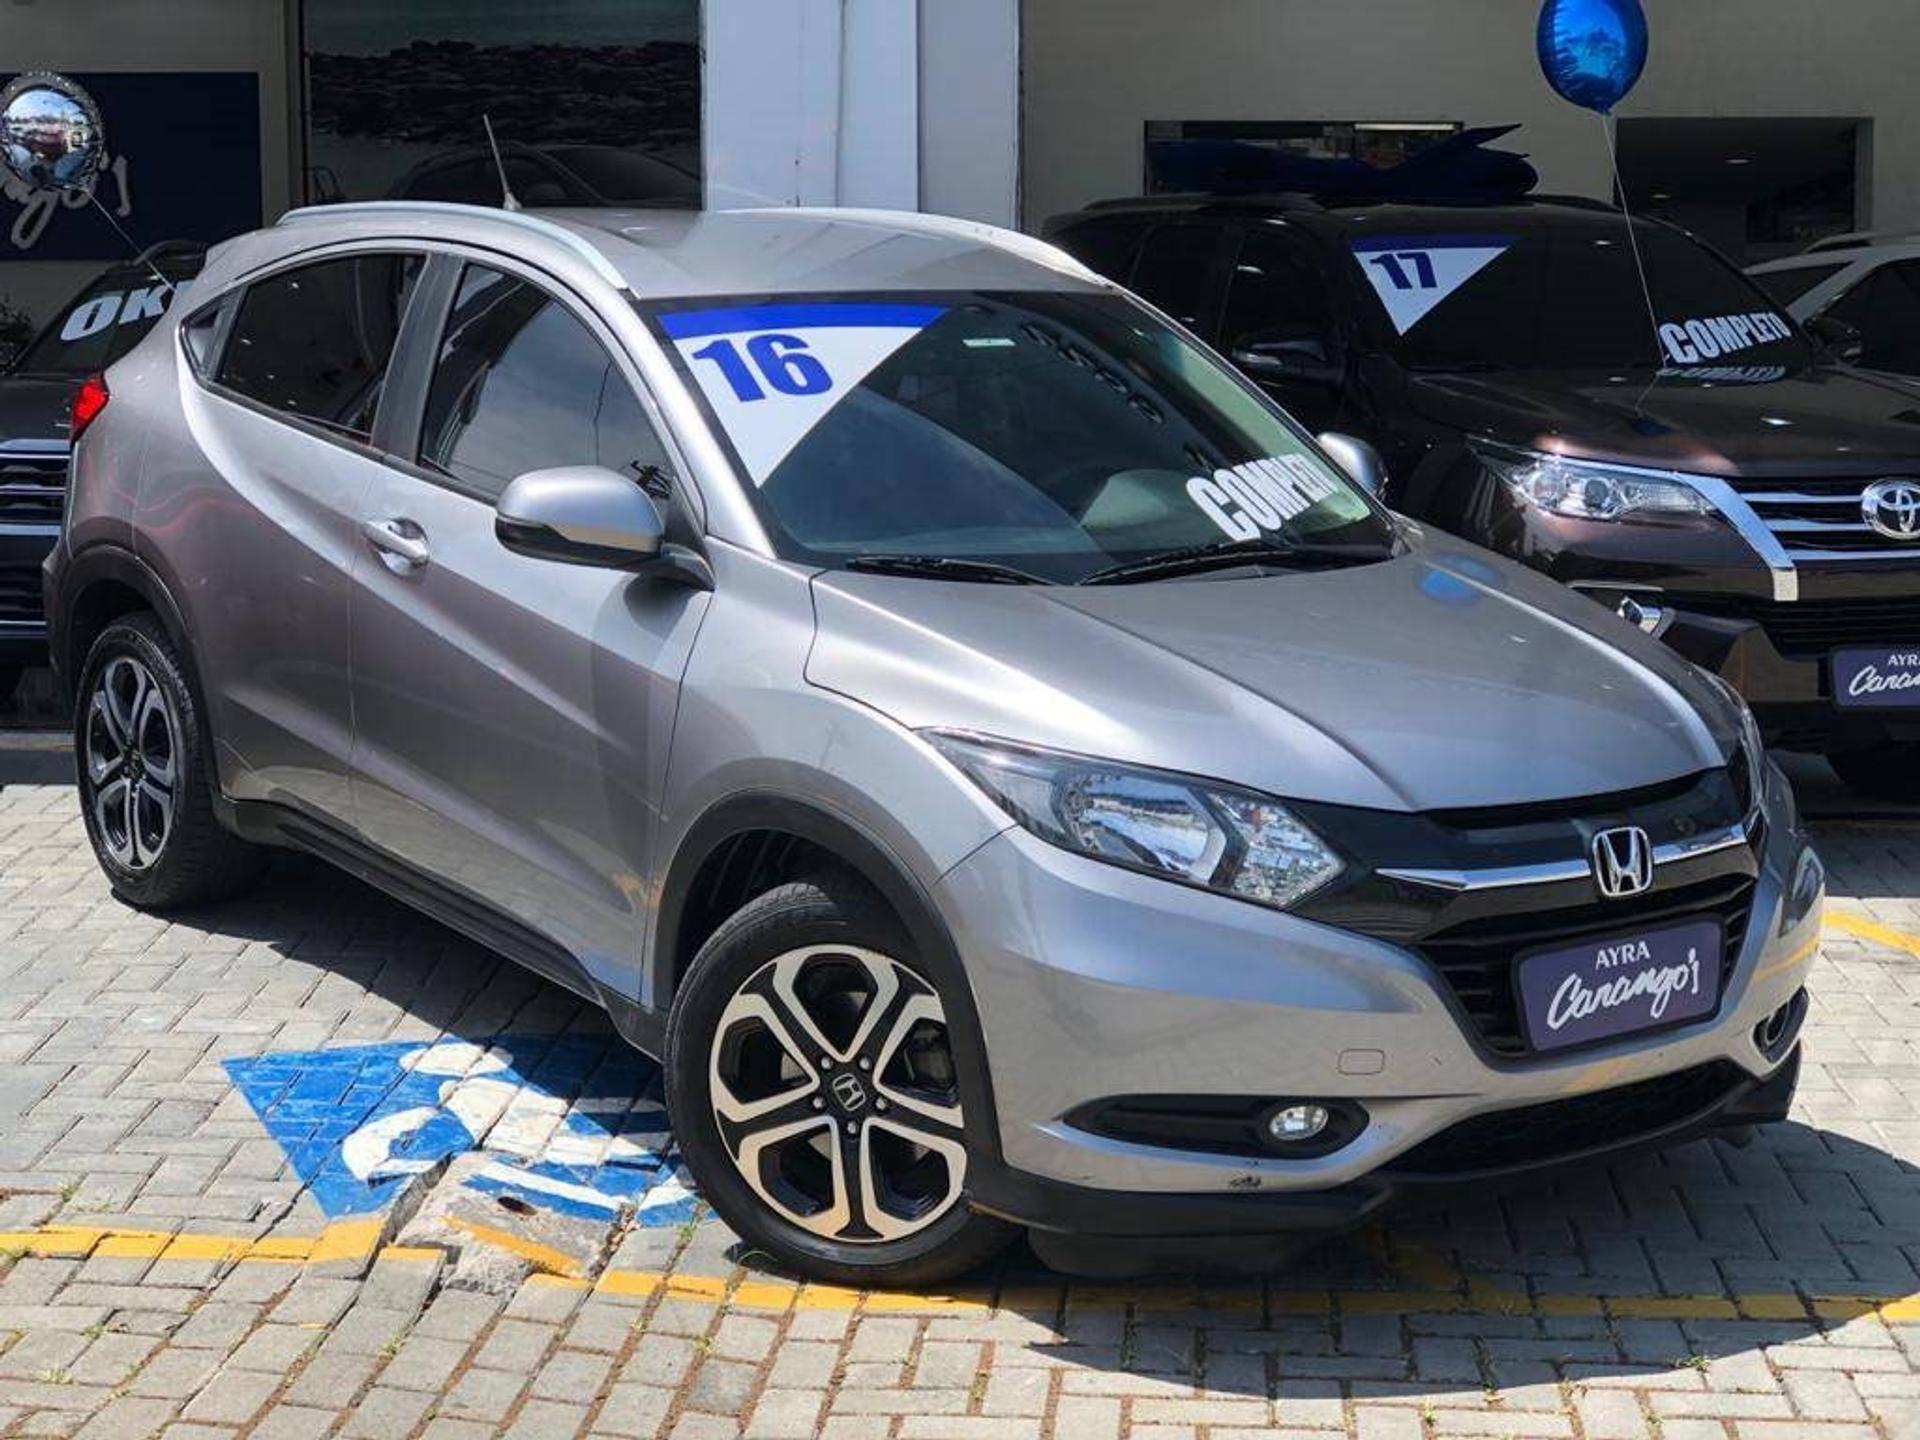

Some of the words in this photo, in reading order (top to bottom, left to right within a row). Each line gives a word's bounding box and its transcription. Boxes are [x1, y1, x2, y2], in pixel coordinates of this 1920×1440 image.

[1369, 252, 1438, 290] 17
[1659, 312, 1792, 363] COMPLETO
[692, 334, 833, 402] 16
[1887, 654, 1920, 666] AYR
[1595, 941, 1651, 969] AYRA
